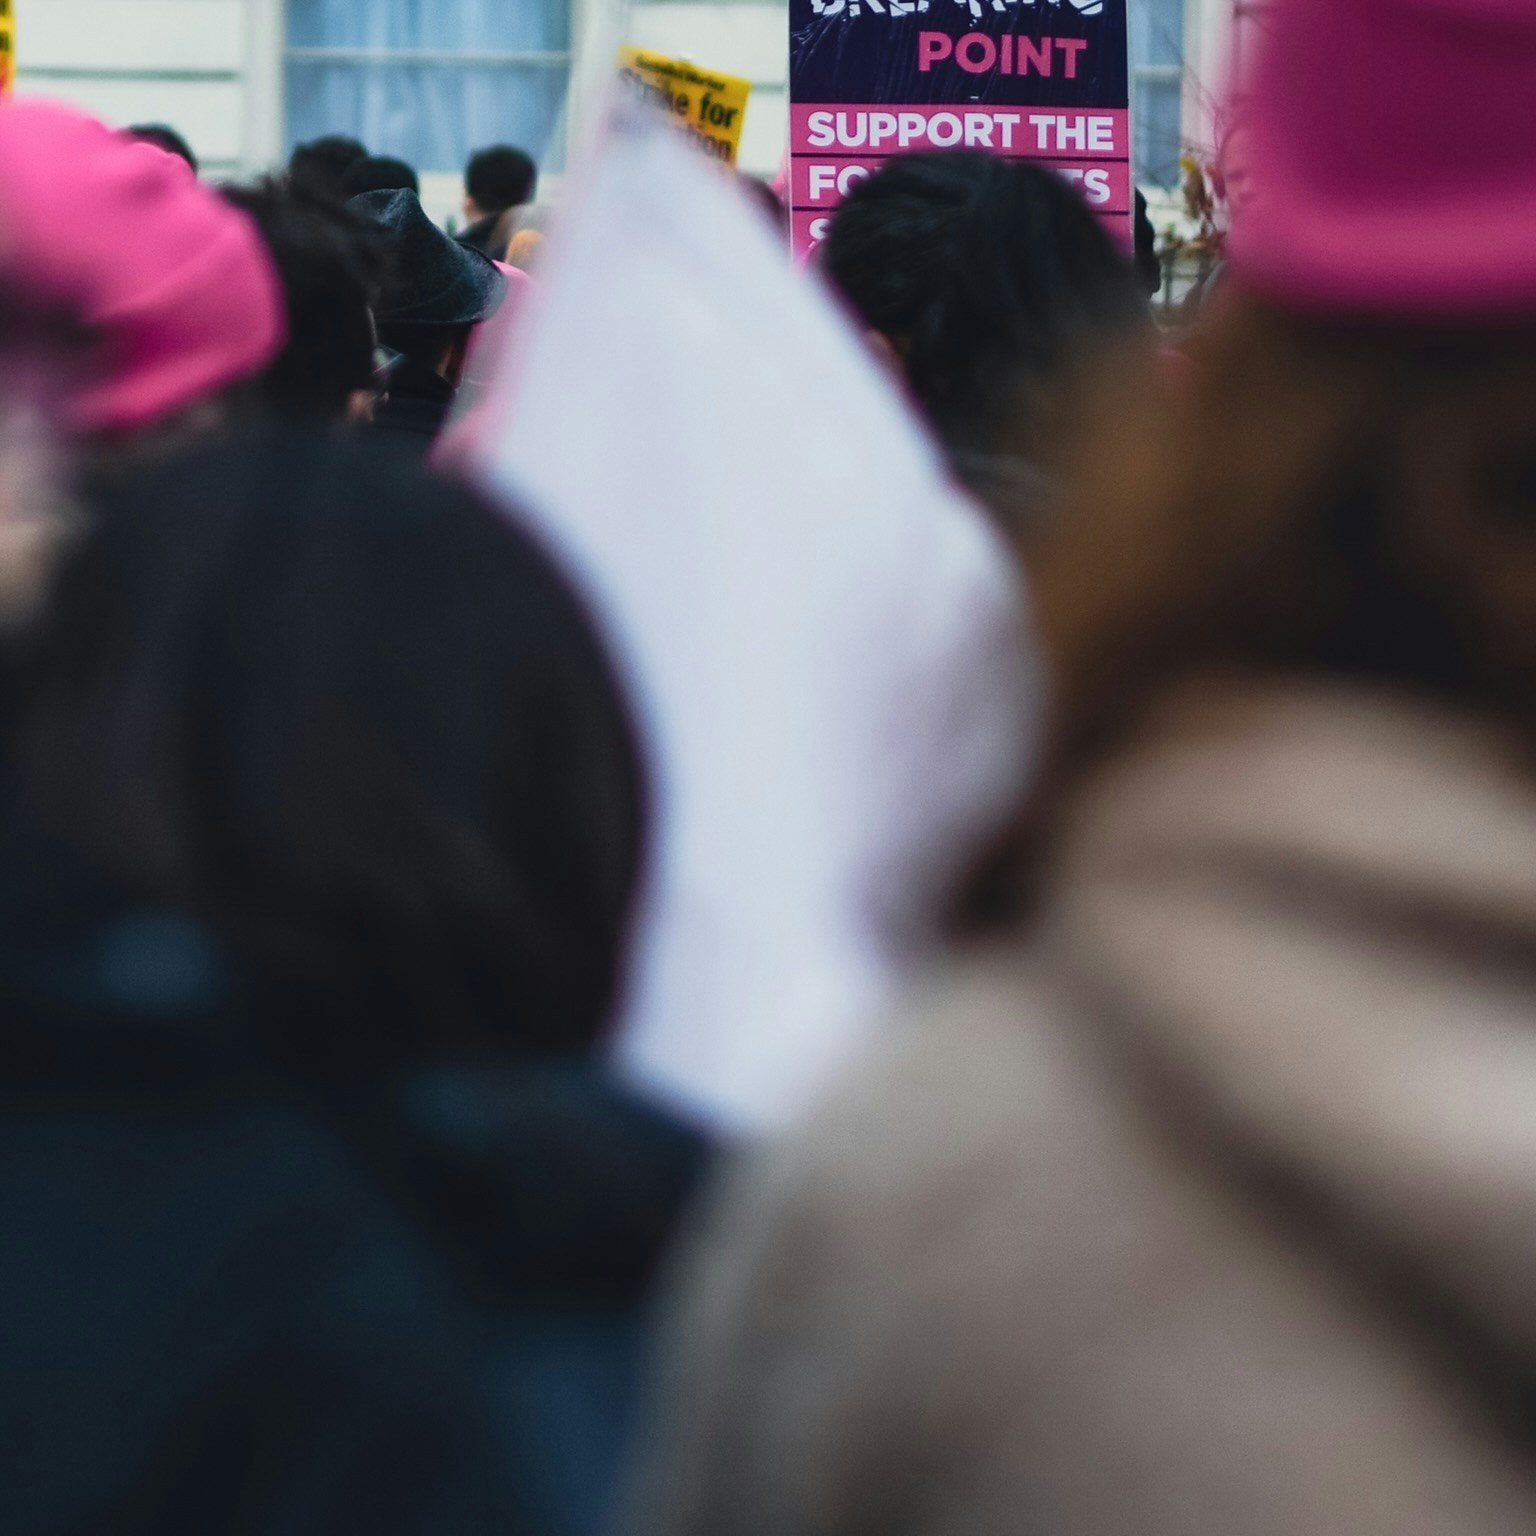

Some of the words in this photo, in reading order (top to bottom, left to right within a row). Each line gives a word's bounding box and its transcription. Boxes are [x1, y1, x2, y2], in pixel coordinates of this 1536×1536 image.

[918, 31, 1088, 79] POINT
[700, 92, 739, 129] for
[807, 112, 1020, 148] SUPPORT
[1029, 115, 1114, 151] THE
